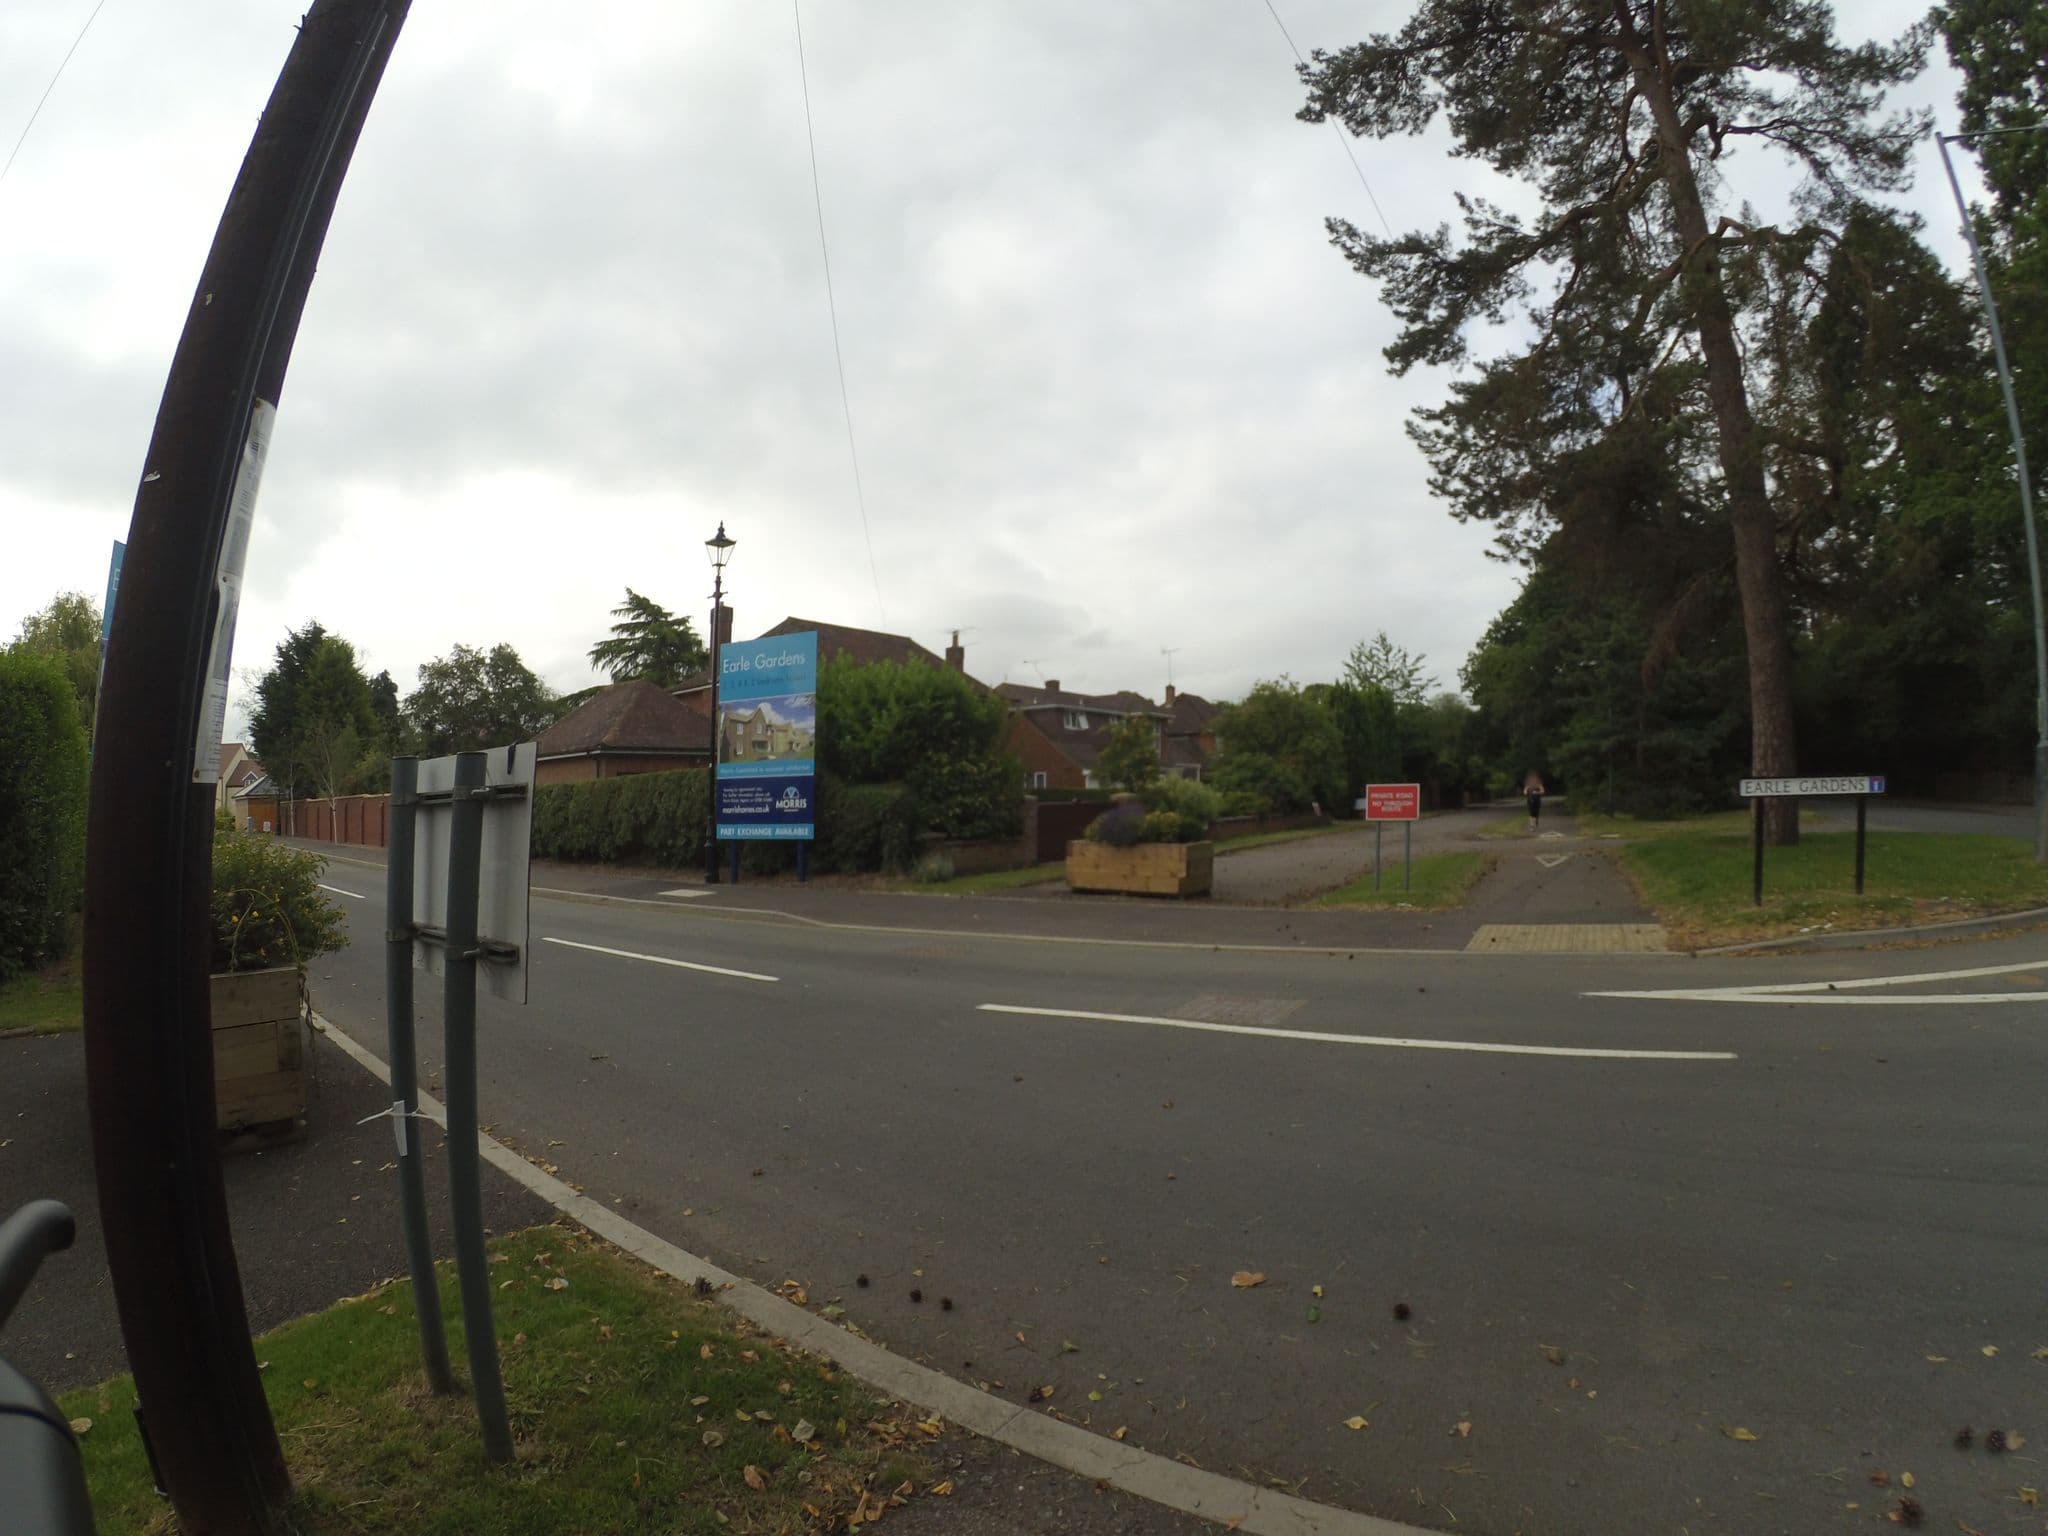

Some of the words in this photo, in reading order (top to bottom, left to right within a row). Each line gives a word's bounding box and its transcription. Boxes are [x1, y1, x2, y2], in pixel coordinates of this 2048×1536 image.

[723, 655, 751, 673] Earle
[755, 650, 806, 669] Gardens
[1745, 781, 1792, 794] EARLE
[1799, 778, 1866, 792] GARDENS
[775, 798, 807, 809] MORRIS
[720, 827, 735, 836] PART
